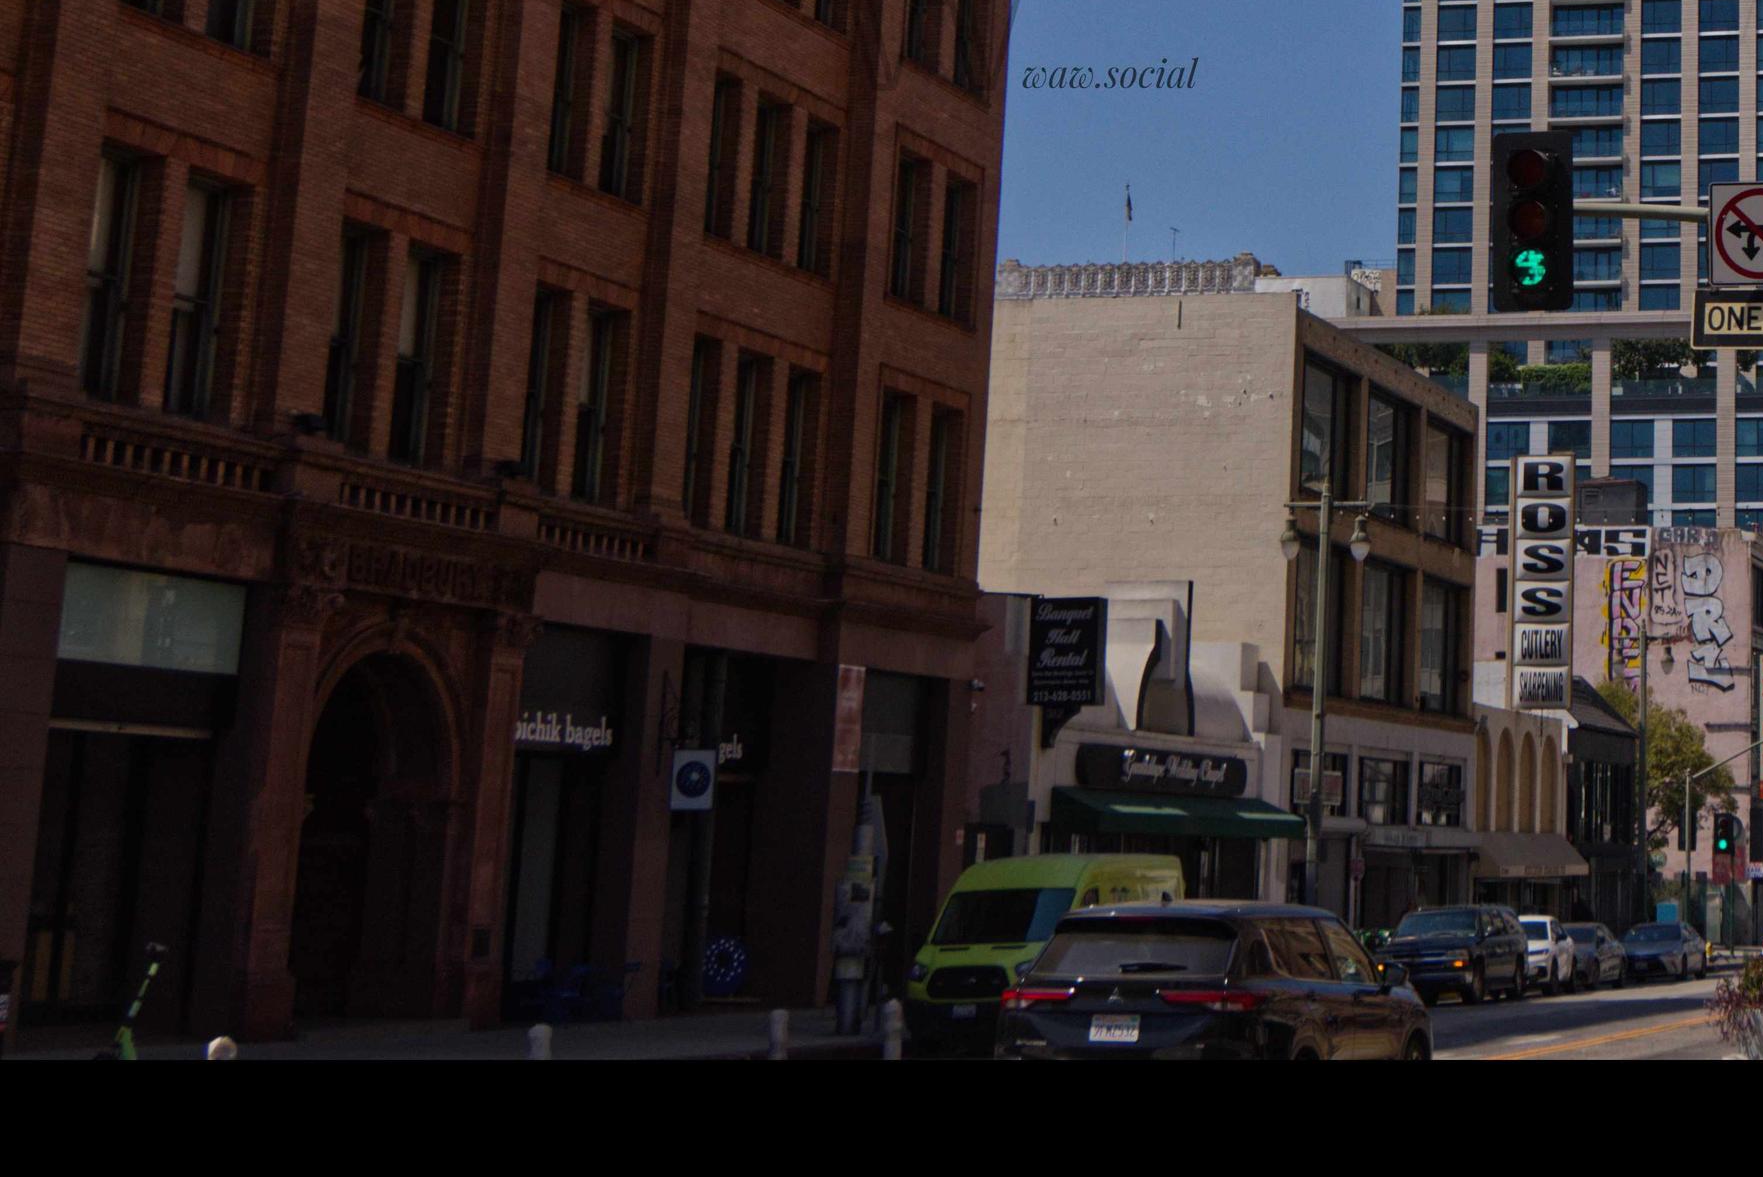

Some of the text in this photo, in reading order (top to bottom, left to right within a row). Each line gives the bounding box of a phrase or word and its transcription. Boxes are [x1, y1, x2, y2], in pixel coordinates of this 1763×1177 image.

[1707, 306, 1762, 331] ONE
[1521, 460, 1567, 617] ROSS
[1036, 603, 1095, 625] Banquet
[1046, 628, 1083, 645] Hall
[1521, 630, 1563, 660] CUTLERY
[1037, 647, 1088, 668] Rental
[1519, 672, 1563, 702] SHARPENING
[565, 713, 614, 750] bagels
